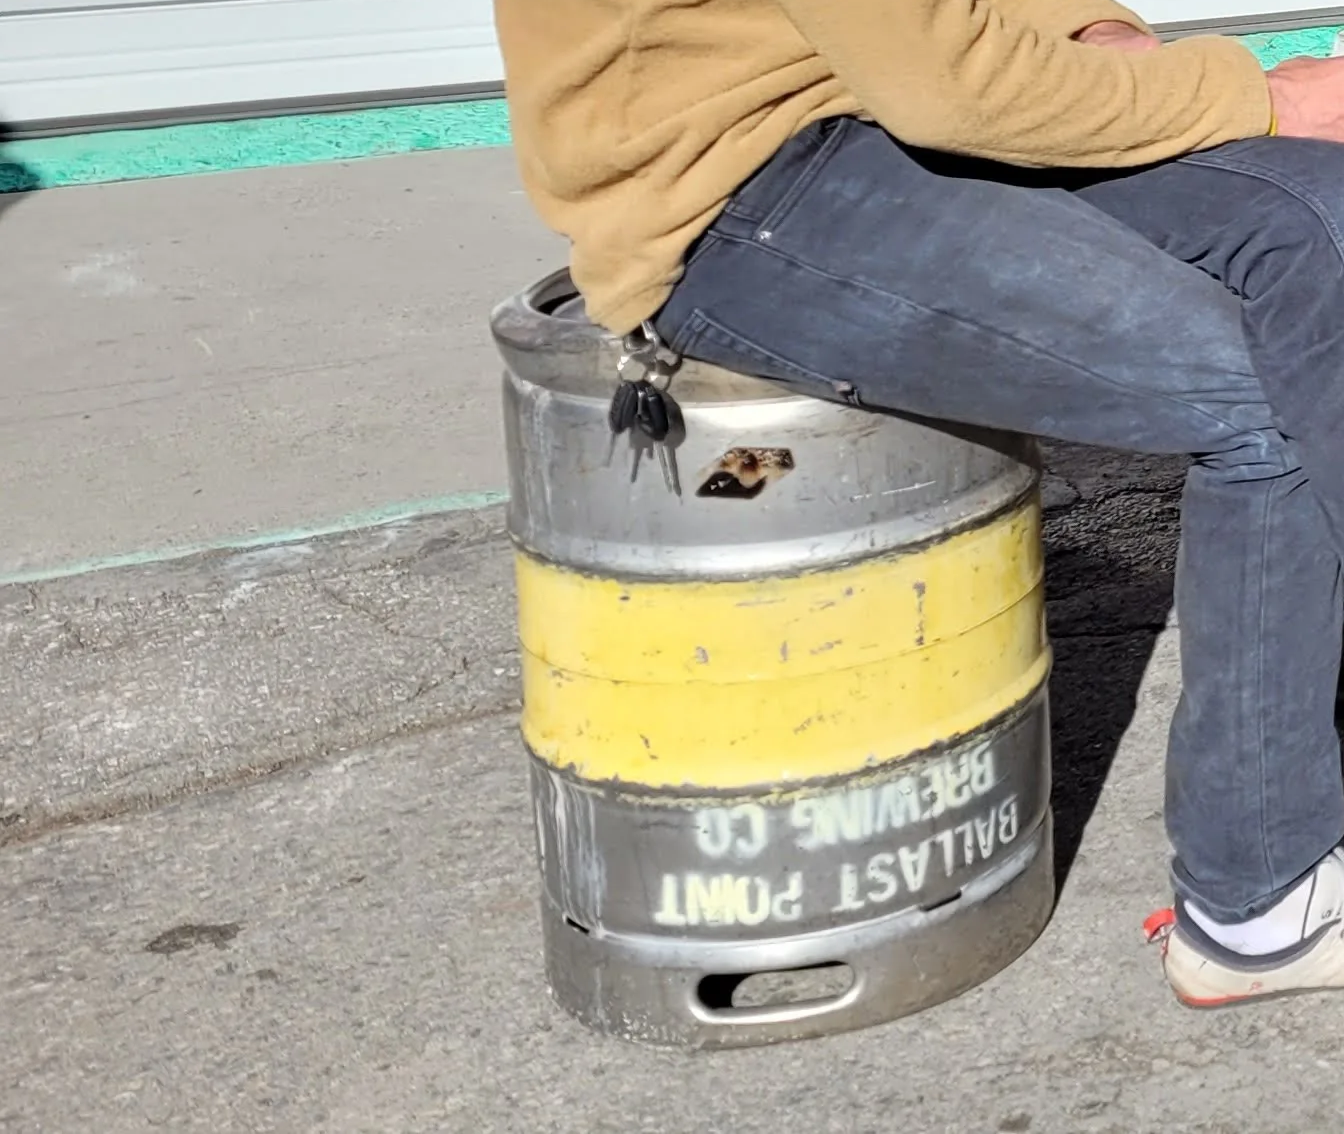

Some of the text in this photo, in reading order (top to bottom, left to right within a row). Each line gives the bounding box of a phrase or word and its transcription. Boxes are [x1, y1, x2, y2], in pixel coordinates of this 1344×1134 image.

[654, 794, 1019, 927] BALLAST POINT
[696, 742, 996, 859] BREWING CO
